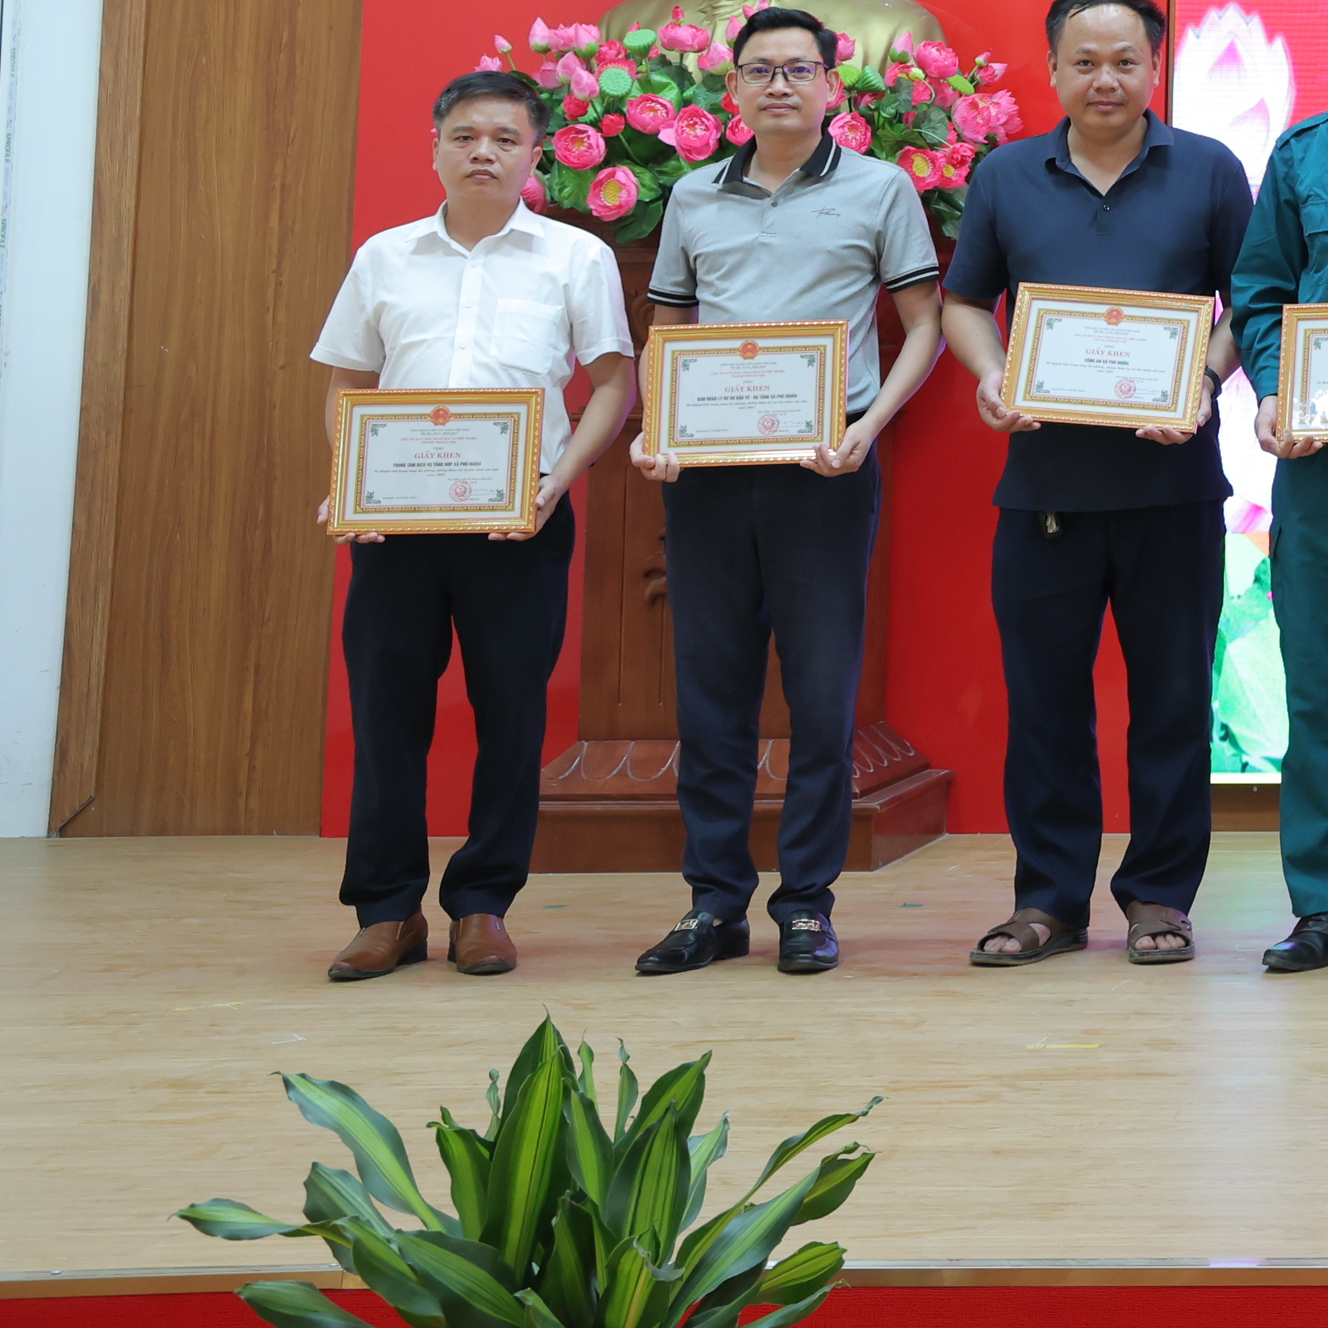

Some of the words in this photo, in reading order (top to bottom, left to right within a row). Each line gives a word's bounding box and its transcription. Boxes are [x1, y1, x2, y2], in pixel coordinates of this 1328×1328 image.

[1085, 347, 1106, 355] GIẤY
[724, 384, 744, 393] GIẤY
[414, 450, 435, 459] GIẤY
